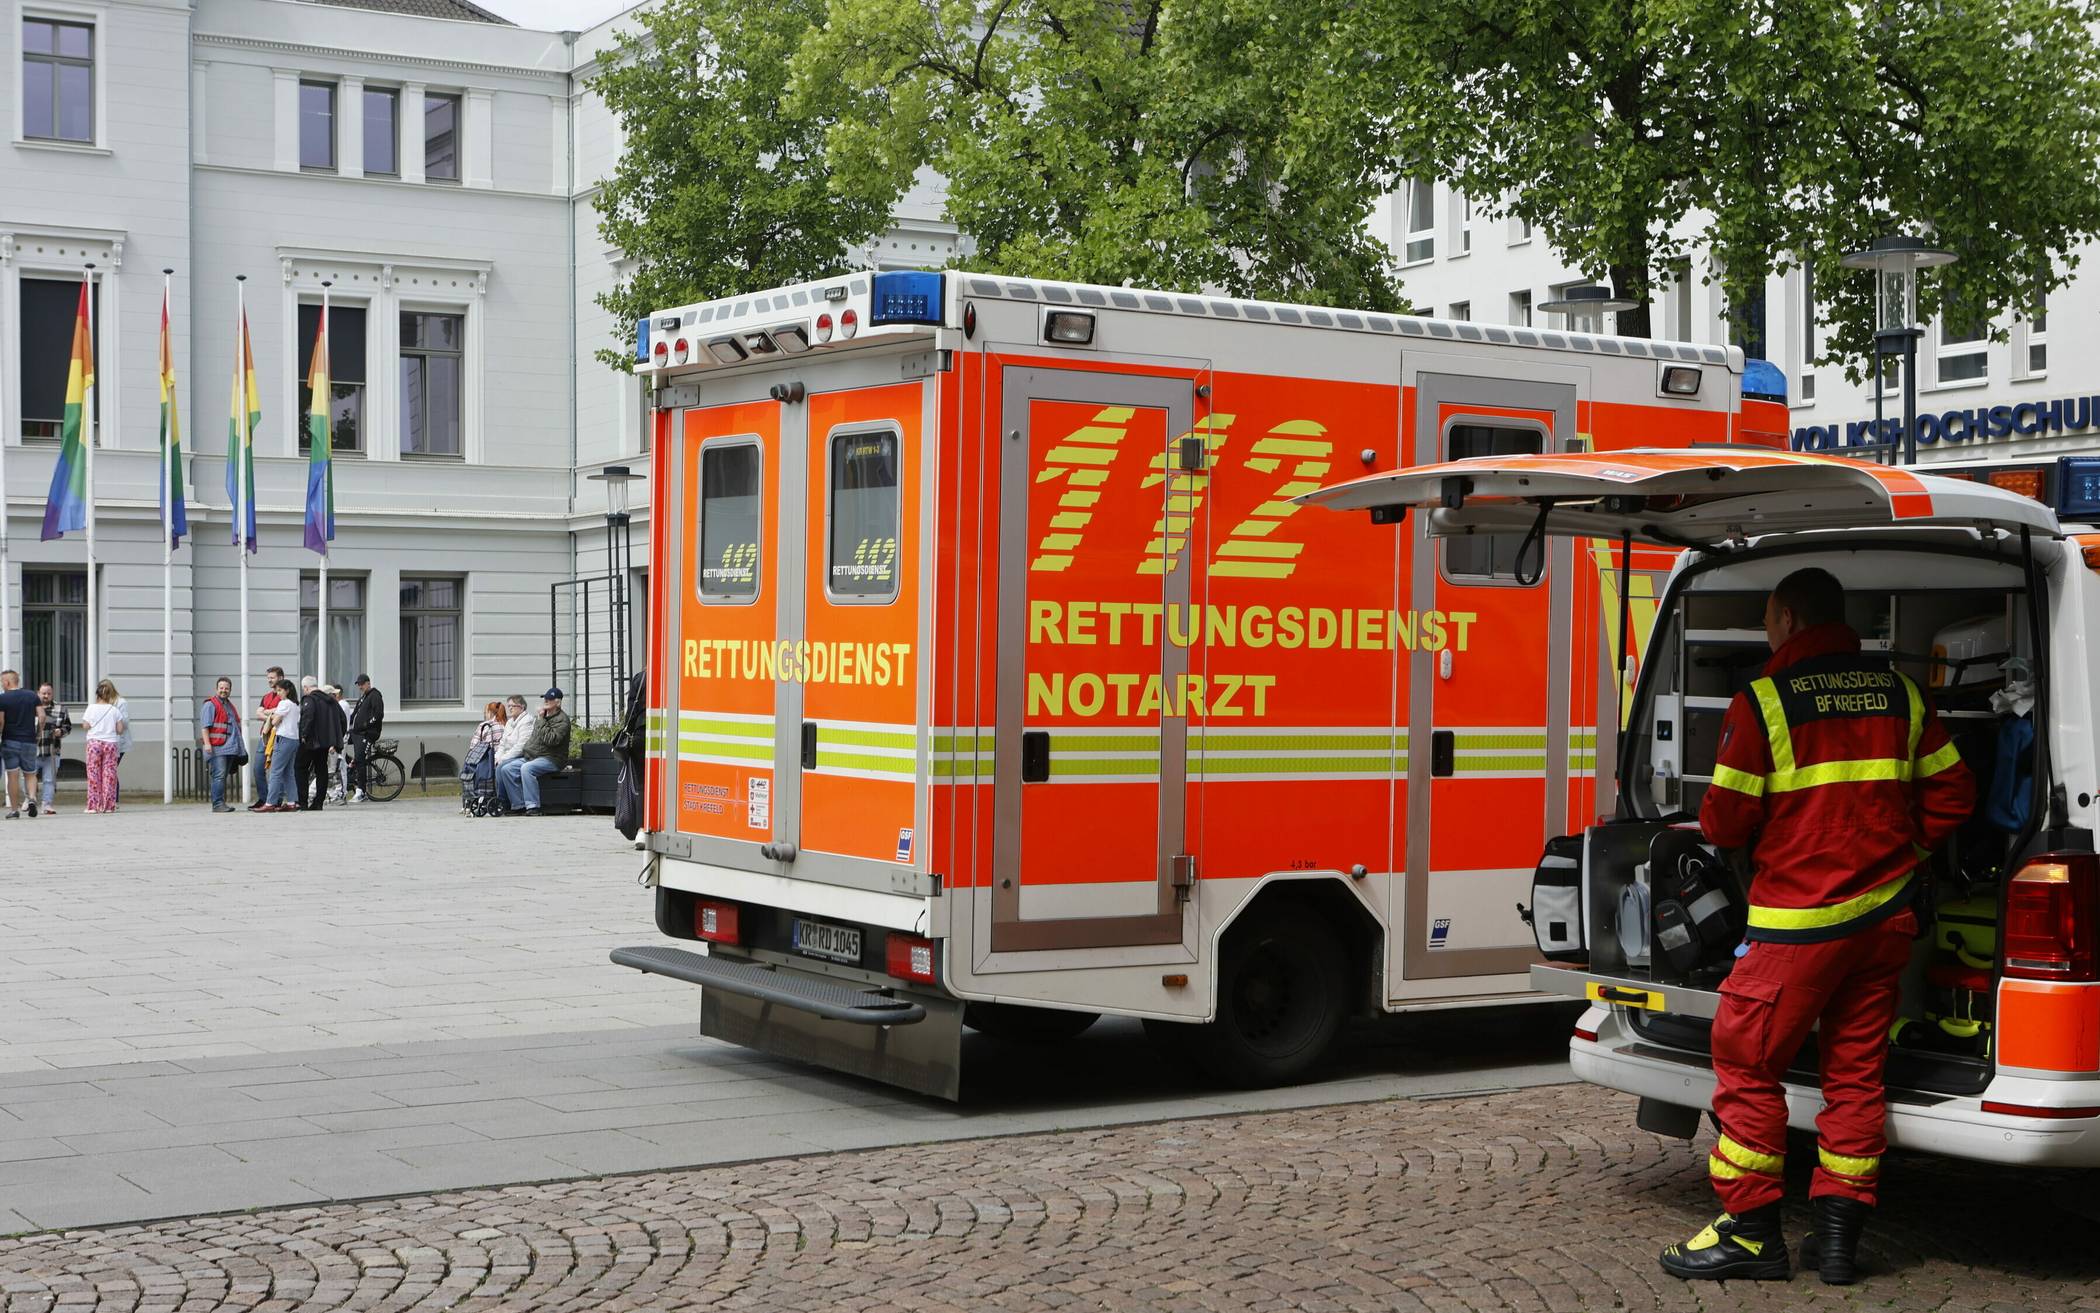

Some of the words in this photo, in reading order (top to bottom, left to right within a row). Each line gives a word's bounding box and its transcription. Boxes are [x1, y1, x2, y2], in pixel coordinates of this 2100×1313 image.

[1030, 406, 1333, 579] 112
[721, 543, 756, 582] 112
[833, 565, 888, 576] RETTUNGSDIENST
[854, 538, 896, 580] 112
[703, 568, 751, 578] RETTUNGSDIENST
[1029, 600, 1477, 652] RETTUNGSDIENST
[684, 639, 910, 686] RETTUNGSDIENST
[1790, 671, 1896, 694] RETTUNGSDIENST
[1028, 673, 1276, 717] NOTARZT
[1815, 694, 1832, 713] BF
[1834, 692, 1889, 712] KREFELD
[684, 783, 729, 798] RETTUNGSDIENST
[700, 803, 724, 815] KREFELD
[900, 830, 912, 840] GSF
[1434, 920, 1451, 929] GSF
[800, 922, 812, 947] KR
[818, 926, 832, 951] RD
[833, 929, 859, 957] 1045
